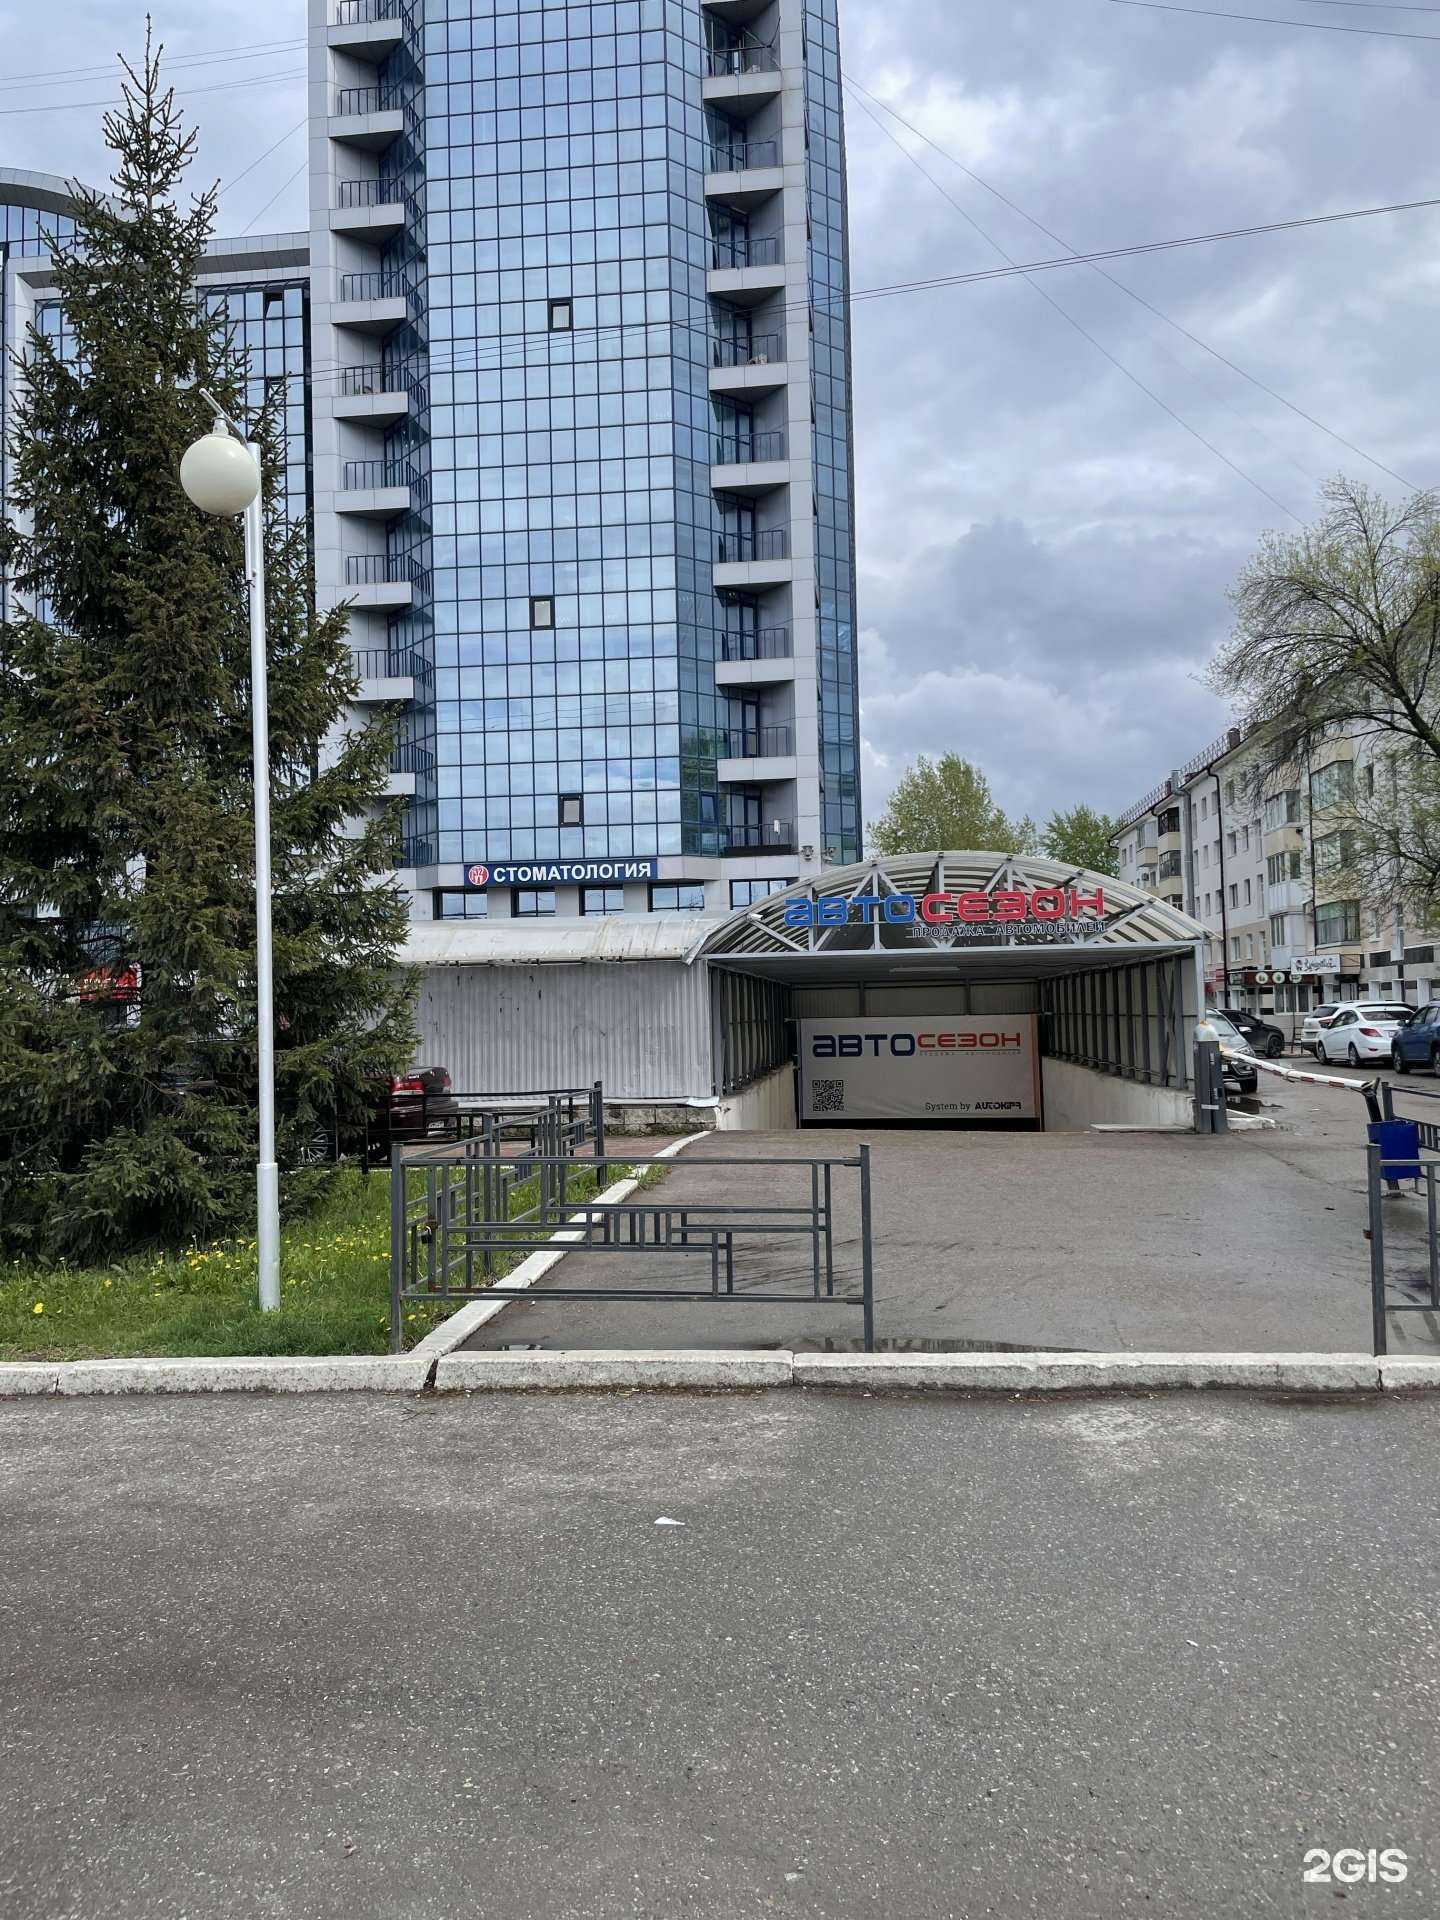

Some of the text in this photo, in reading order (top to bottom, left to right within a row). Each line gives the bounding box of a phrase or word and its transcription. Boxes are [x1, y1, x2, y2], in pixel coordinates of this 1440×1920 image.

[493, 862, 651, 882] СТОМАТОЛОГИЯ
[912, 921, 1106, 938] ПРОДАЖА АВТОМОБИЛЕЙ
[924, 1102, 958, 1112] System
[960, 1102, 971, 1112] by
